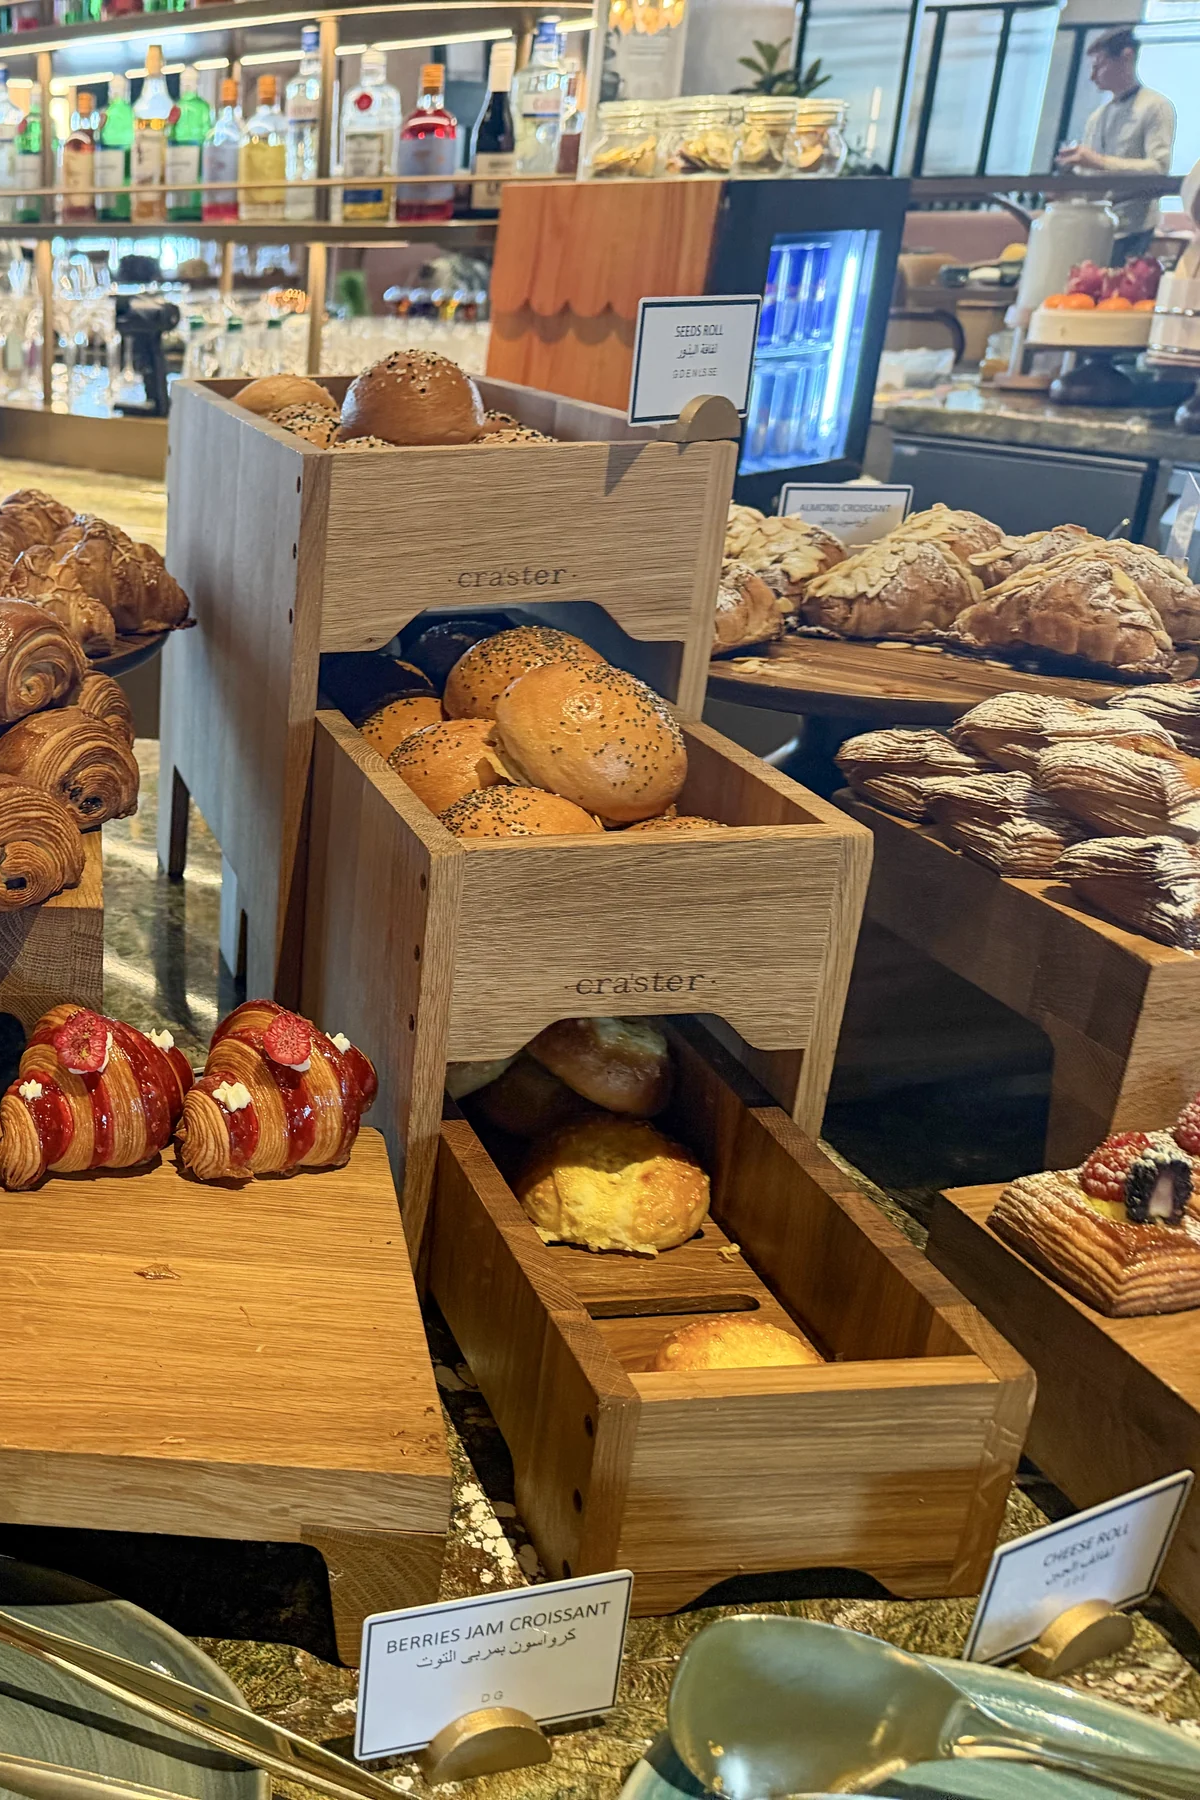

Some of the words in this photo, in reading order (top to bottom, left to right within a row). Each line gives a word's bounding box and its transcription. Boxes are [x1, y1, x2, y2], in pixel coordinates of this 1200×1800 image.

[674, 325, 702, 337] SEEDS
[703, 324, 723, 336] ROLL
[800, 503, 840, 512] ALMOND
[841, 503, 891, 513] CROISSANT
[1043, 1536, 1095, 1567] CHEESE
[1097, 1522, 1129, 1546] ROLL
[386, 1628, 461, 1654] BERRIES
[464, 1620, 504, 1640] JAM
[509, 1601, 612, 1632] CROISSANT
[415, 1649, 457, 1670] التوت
